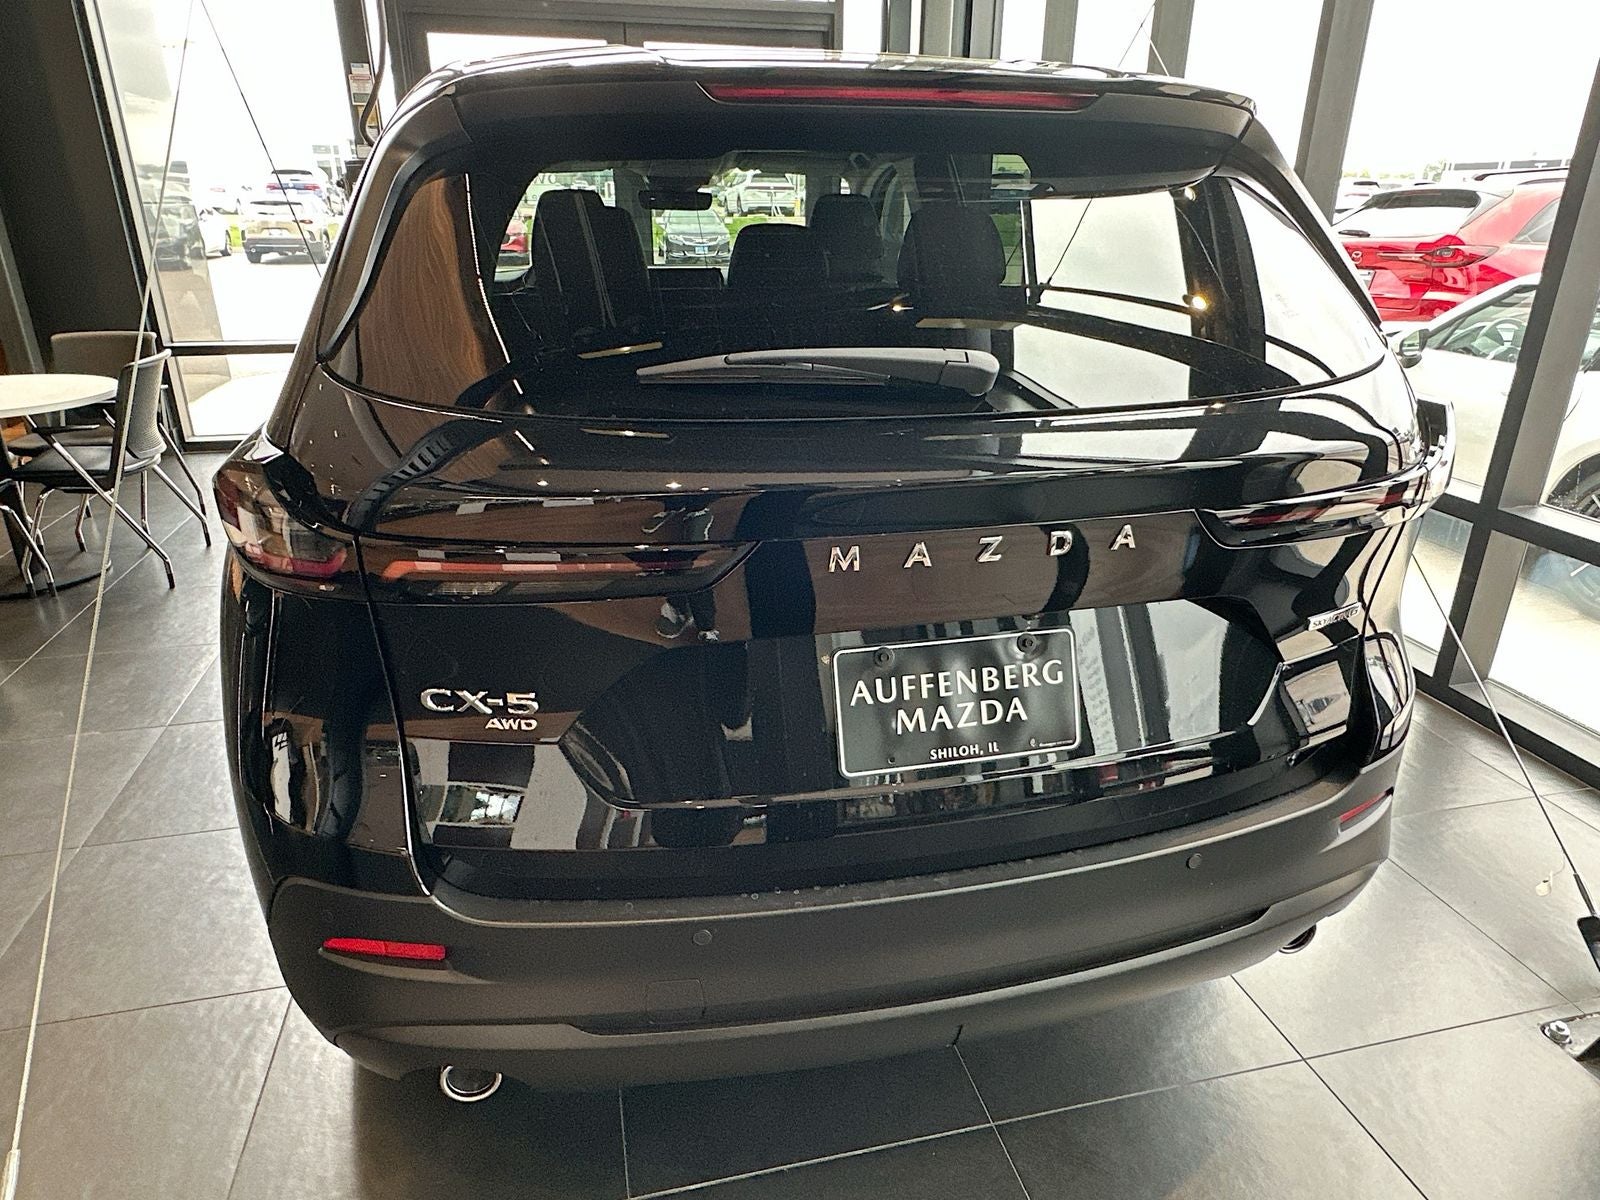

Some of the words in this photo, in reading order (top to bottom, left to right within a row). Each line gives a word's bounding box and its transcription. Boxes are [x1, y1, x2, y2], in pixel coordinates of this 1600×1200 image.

[828, 524, 1137, 572] MAZDA
[850, 659, 1064, 707] AUFFENBERG
[420, 688, 539, 714] CX-5
[896, 696, 1028, 735] MAZDA
[485, 718, 538, 731] AWD
[930, 743, 984, 760] SHILOH,
[988, 741, 1000, 753] IL
